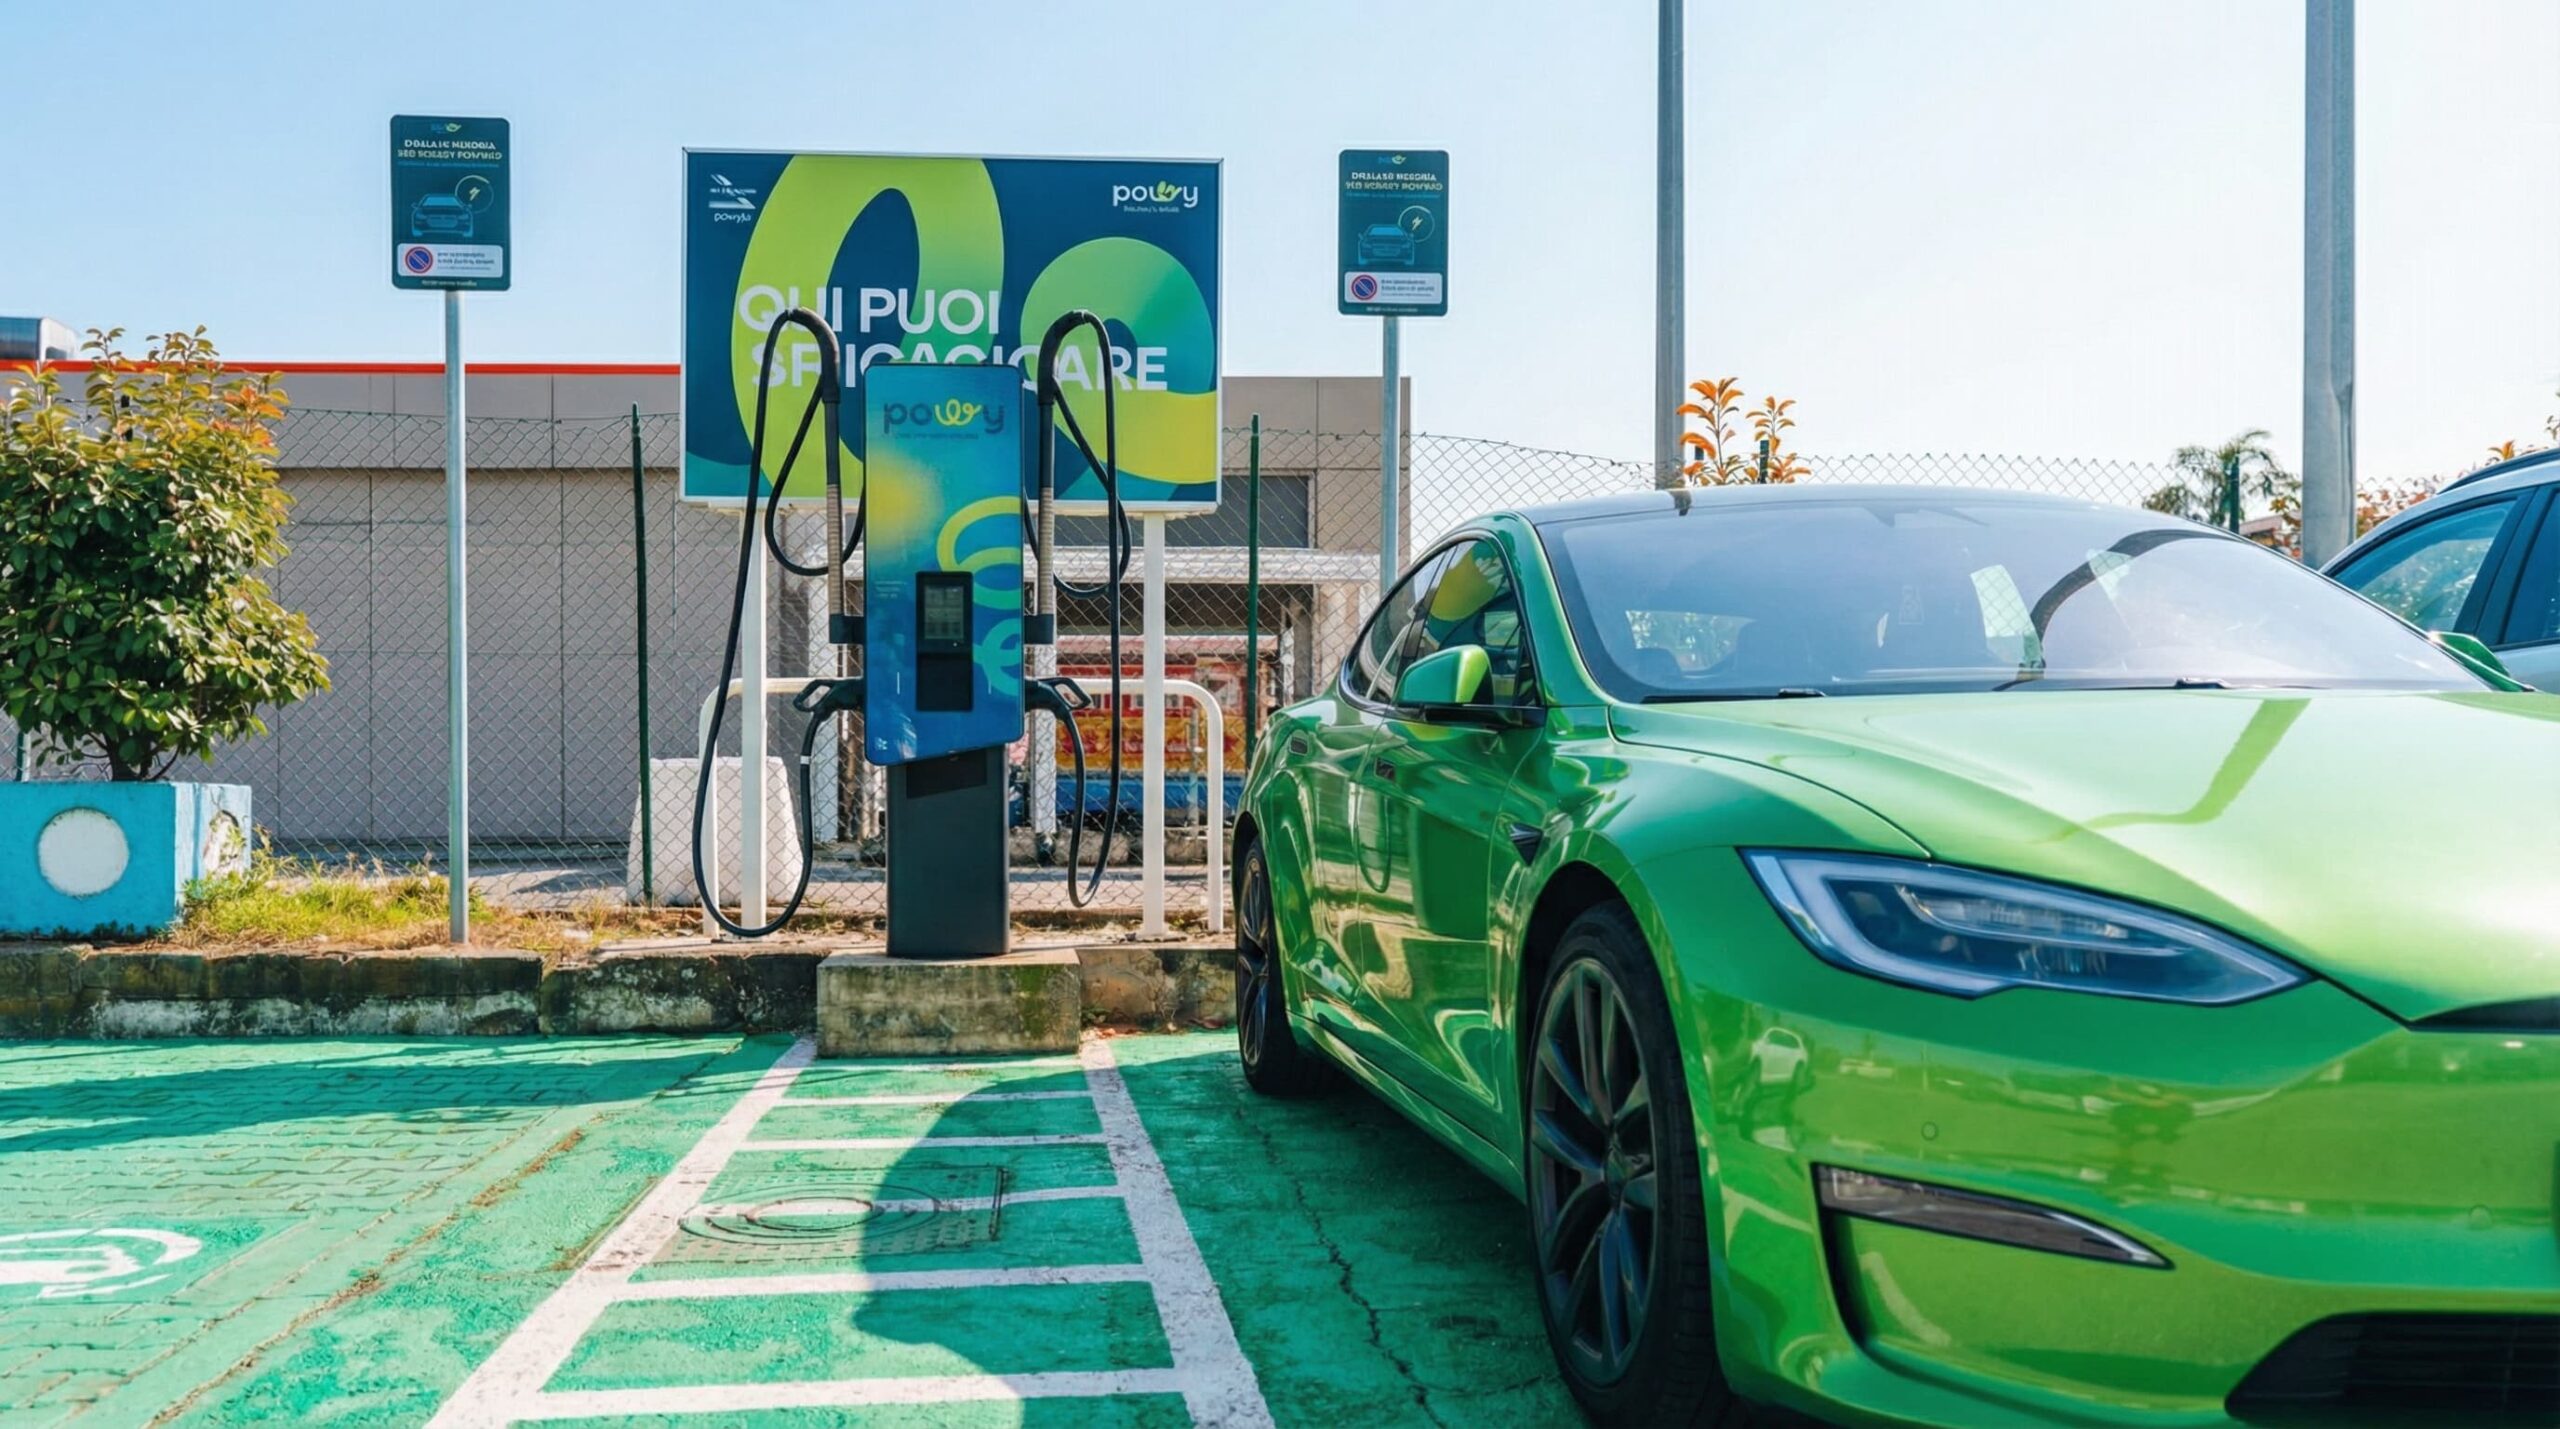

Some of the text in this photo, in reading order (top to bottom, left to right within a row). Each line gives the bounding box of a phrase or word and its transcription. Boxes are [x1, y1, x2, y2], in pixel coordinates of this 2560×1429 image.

[738, 284, 999, 335] QUI PUOI
[883, 398, 1005, 434] powy
